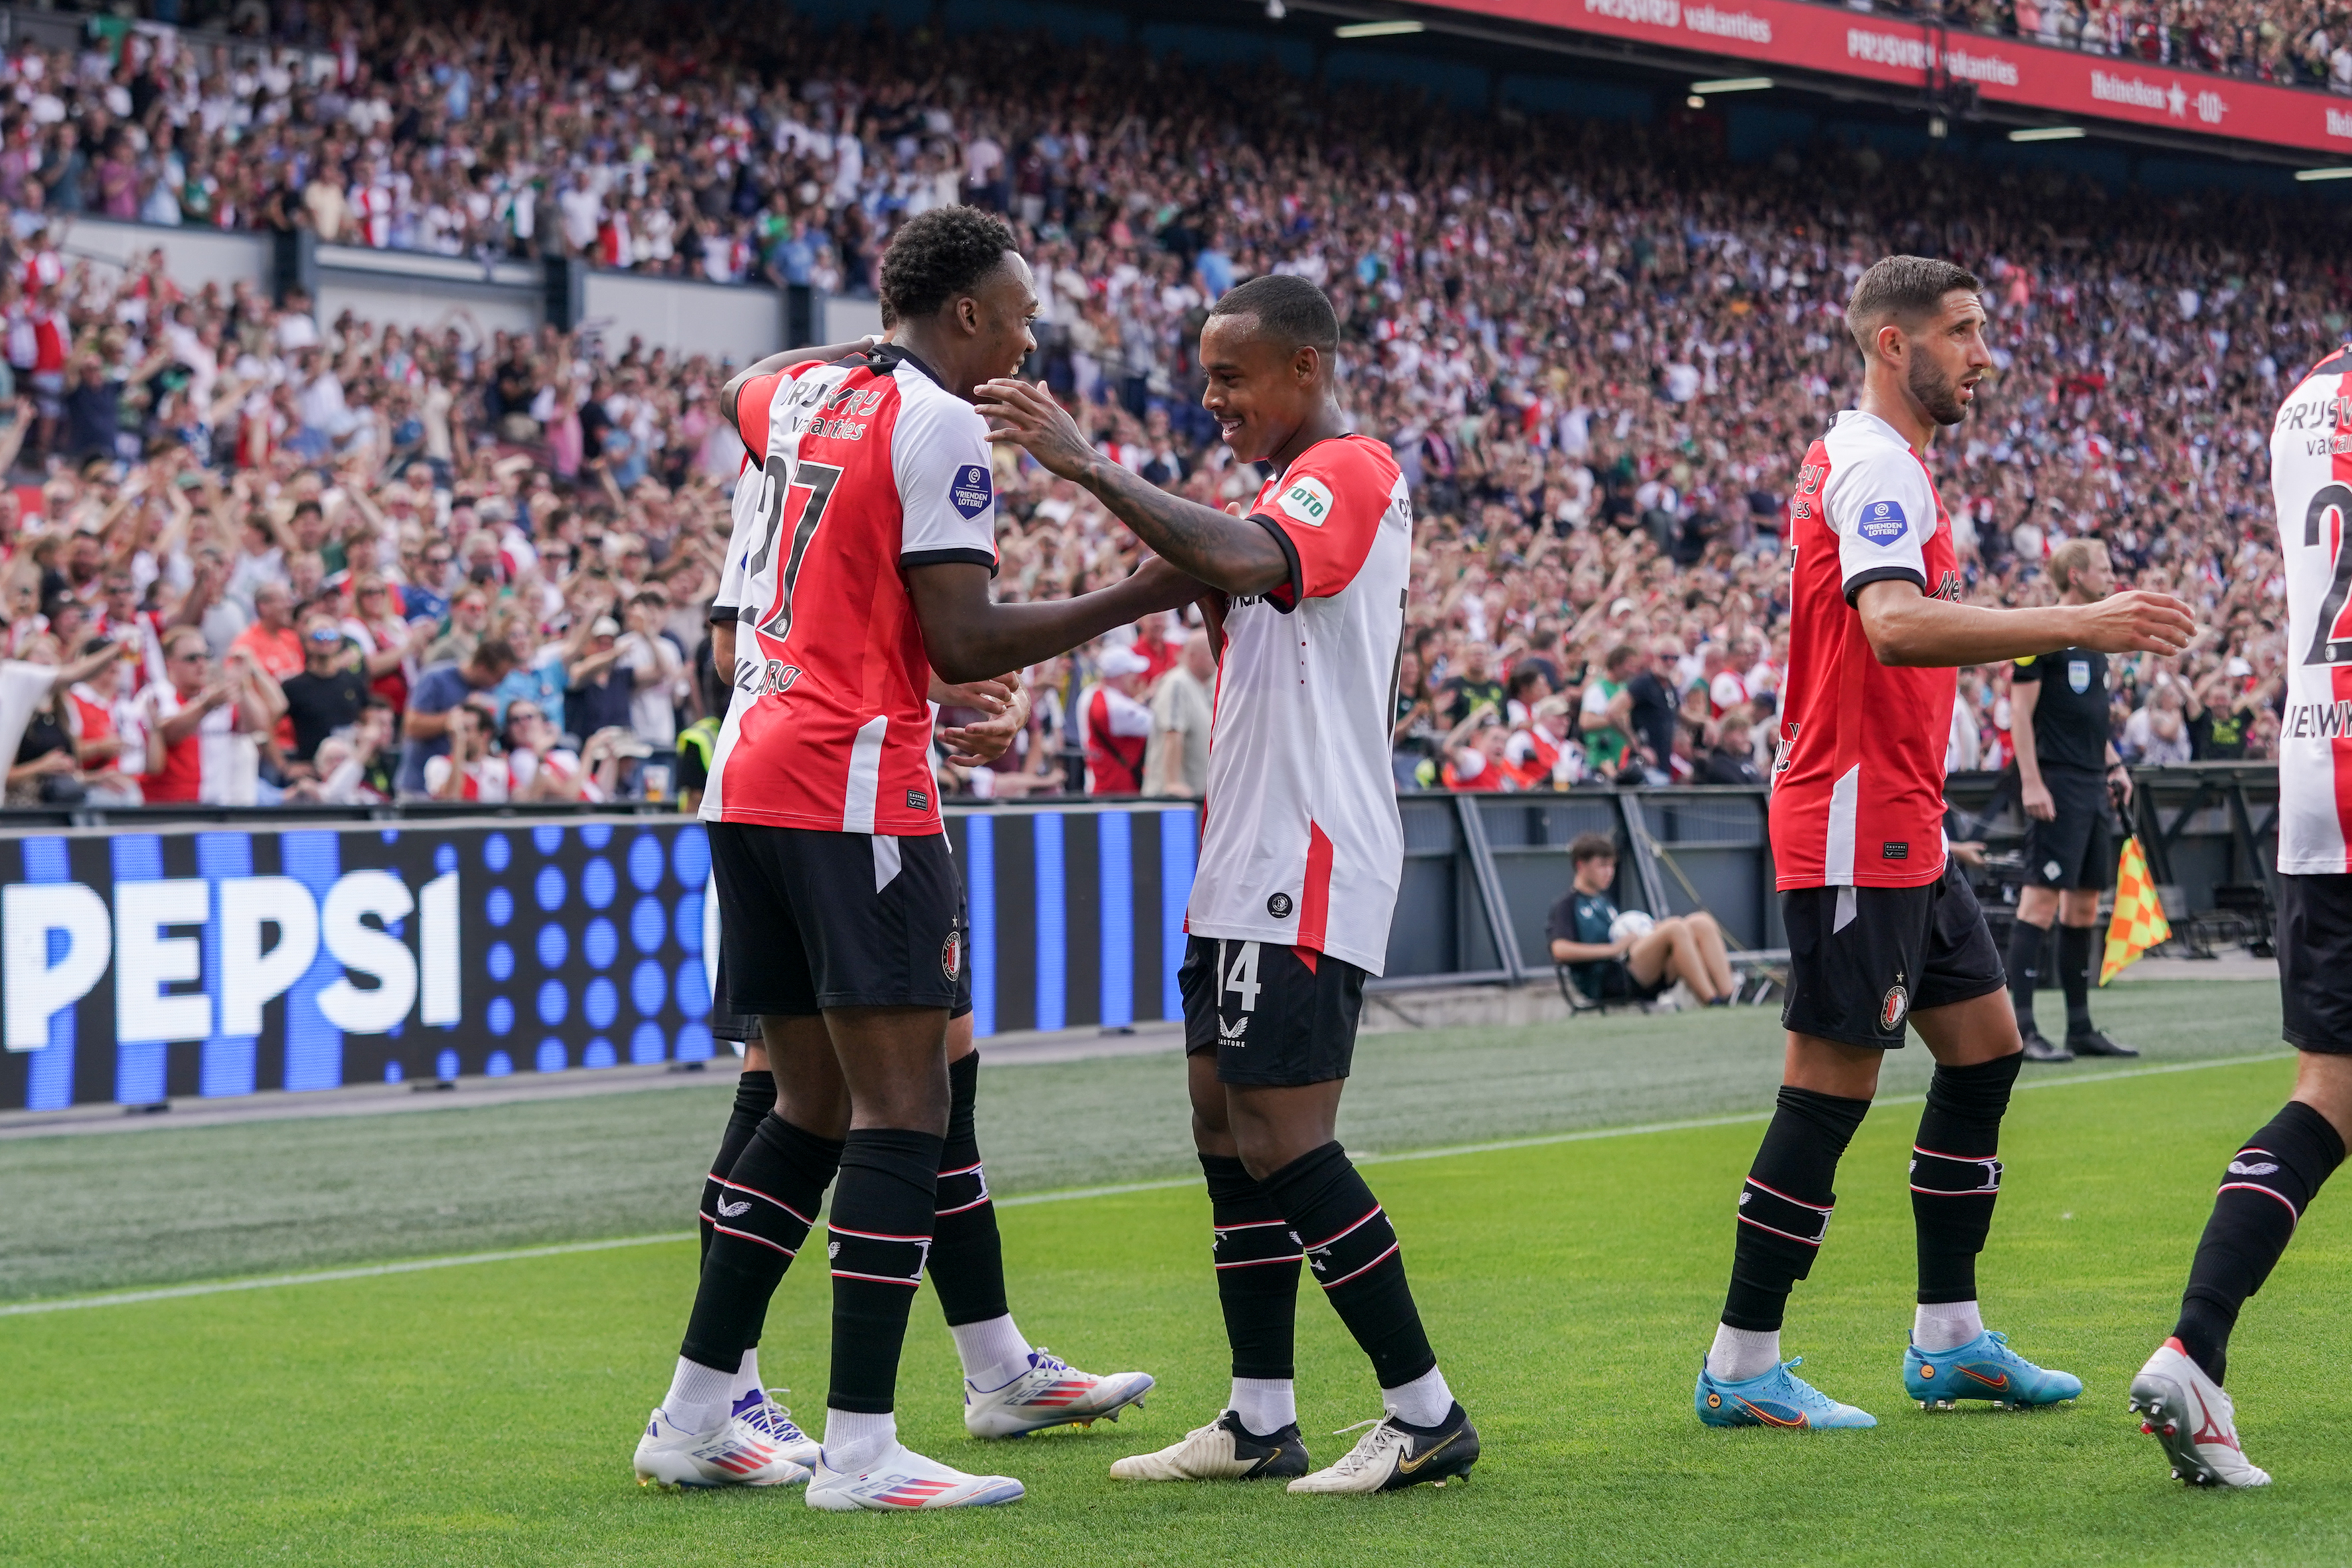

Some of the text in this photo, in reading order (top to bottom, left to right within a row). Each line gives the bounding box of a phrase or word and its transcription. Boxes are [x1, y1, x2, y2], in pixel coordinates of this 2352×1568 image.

[2090, 69, 2167, 110] Heineken
[955, 490, 988, 501] VRIENDEN
[958, 498, 983, 509] LOTERIJ
[1863, 522, 1903, 531] VRIENDEN
[1868, 528, 1899, 537] LOTERIJ
[2, 869, 460, 1052] PEPSI
[1217, 940, 1261, 1012] 14
